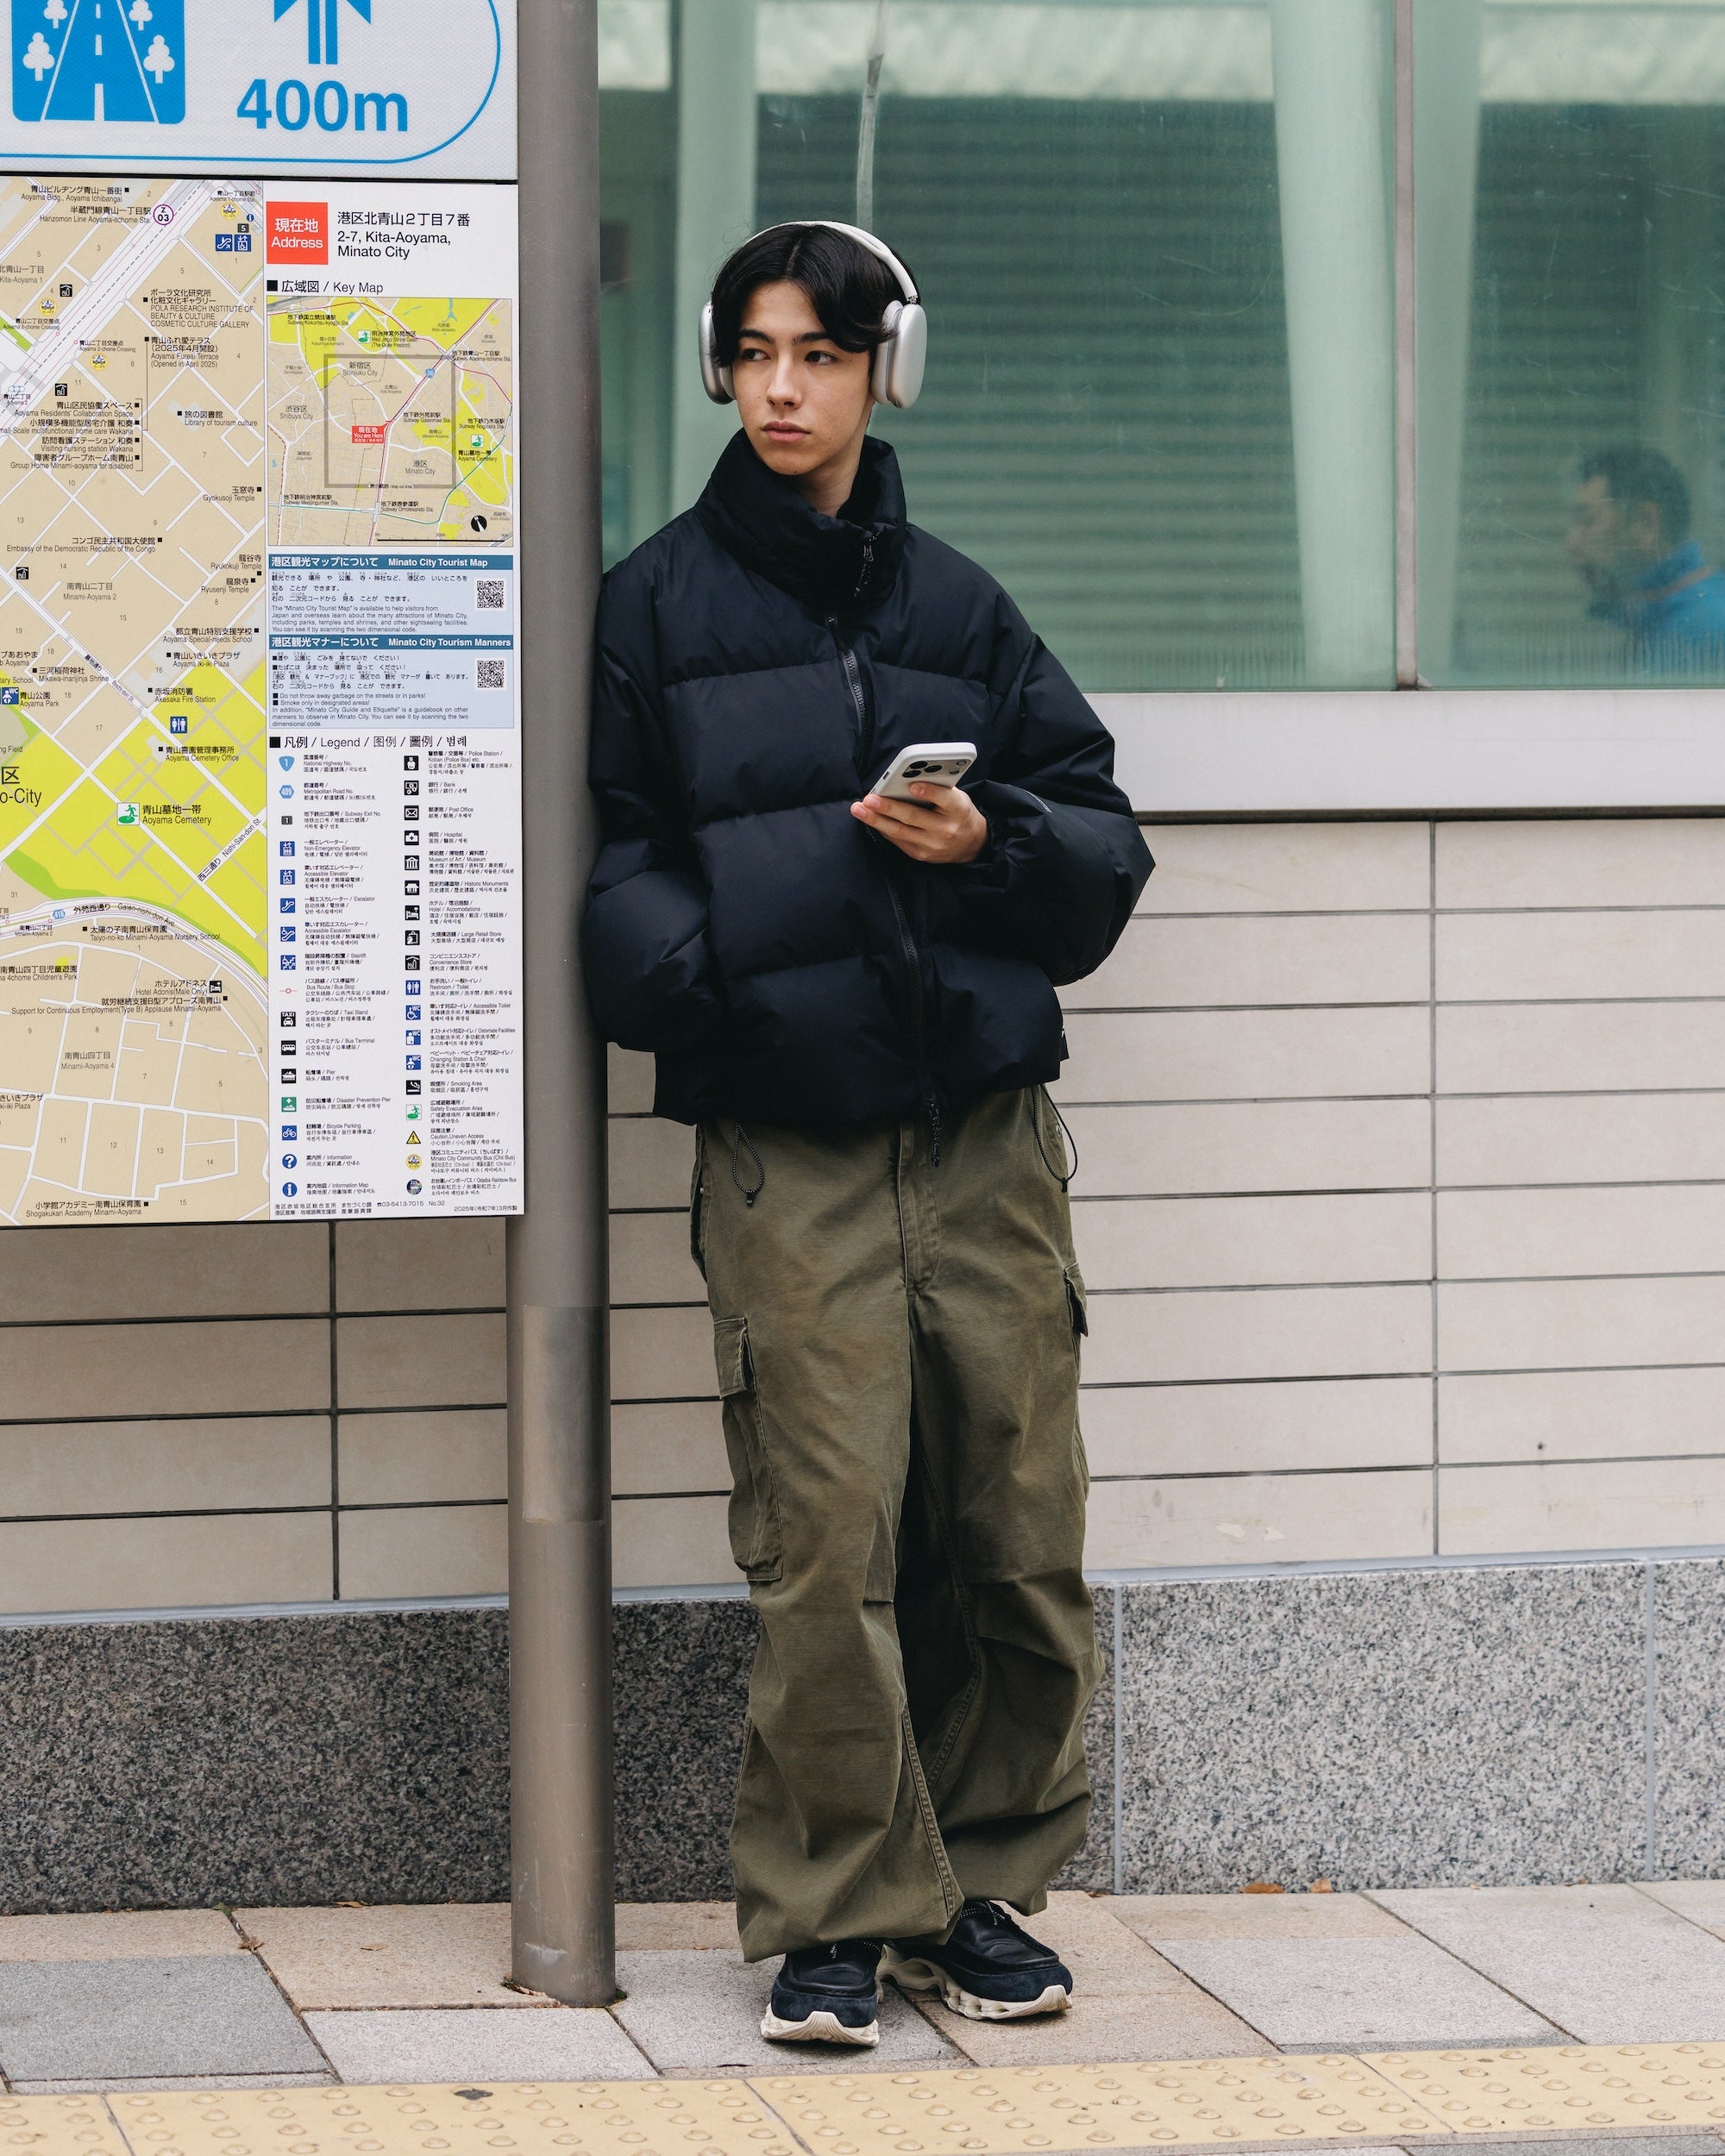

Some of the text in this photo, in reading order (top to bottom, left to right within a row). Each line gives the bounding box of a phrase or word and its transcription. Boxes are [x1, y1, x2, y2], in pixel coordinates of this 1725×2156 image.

[236, 79, 407, 131] 400m
[275, 218, 318, 233] 現在地
[272, 236, 323, 248] Address
[338, 231, 450, 245] 2-7, Kita-Aoyama,
[338, 246, 410, 260] Minato City
[281, 281, 319, 292] 広域図
[334, 283, 354, 293] Key
[359, 284, 383, 294] Map
[272, 557, 379, 567] 港区観光マップについて
[419, 559, 437, 567] City
[470, 559, 487, 567] Map
[272, 637, 379, 647] 港区観光マナーについて
[419, 638, 437, 648] City
[284, 736, 307, 748] 凡例
[321, 737, 360, 749] Legend
[447, 736, 467, 747] 범례
[1, 767, 20, 784] 区
[142, 805, 201, 814] 青山墓地一帯
[142, 816, 211, 825] Aoyama Cemetery
[191, 987, 208, 996] Only)
[26, 1209, 63, 1218] Shogakukan
